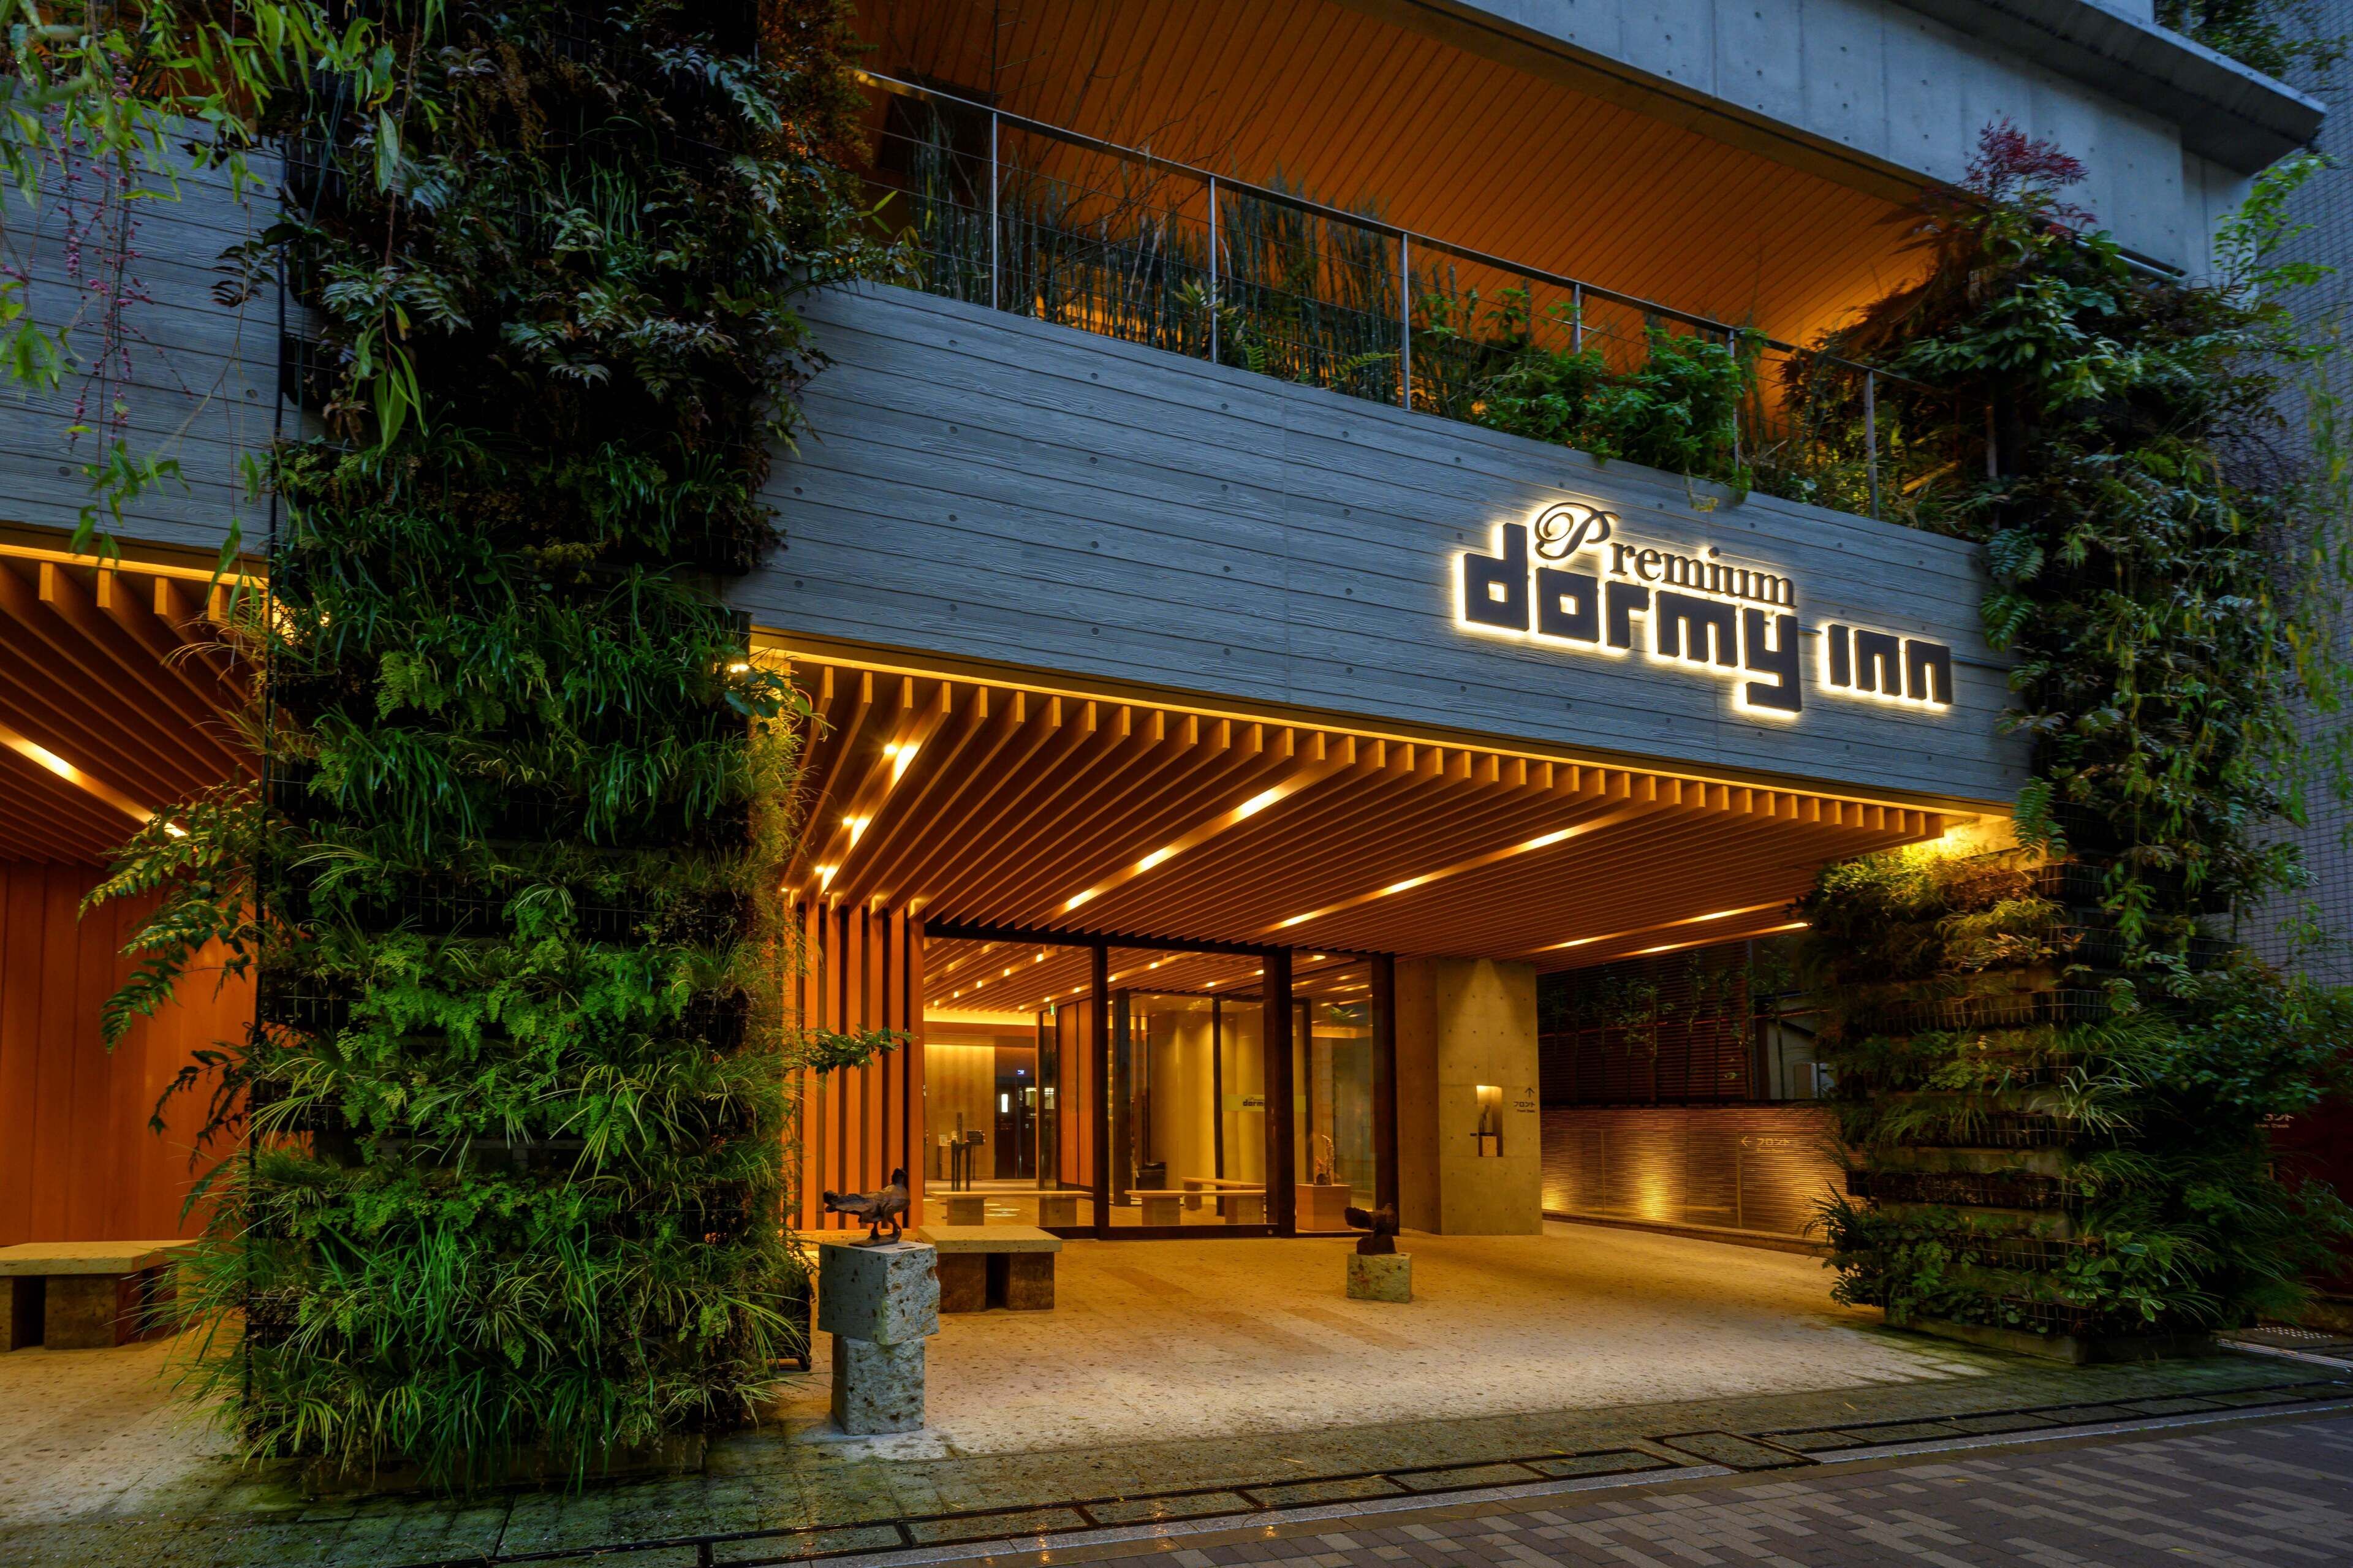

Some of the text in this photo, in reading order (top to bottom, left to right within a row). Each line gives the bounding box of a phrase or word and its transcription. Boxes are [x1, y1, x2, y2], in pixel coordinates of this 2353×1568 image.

[1534, 502, 1797, 609] Premium
[1464, 523, 1952, 713] dormy inn
[2262, 1113, 2295, 1122] ロント
